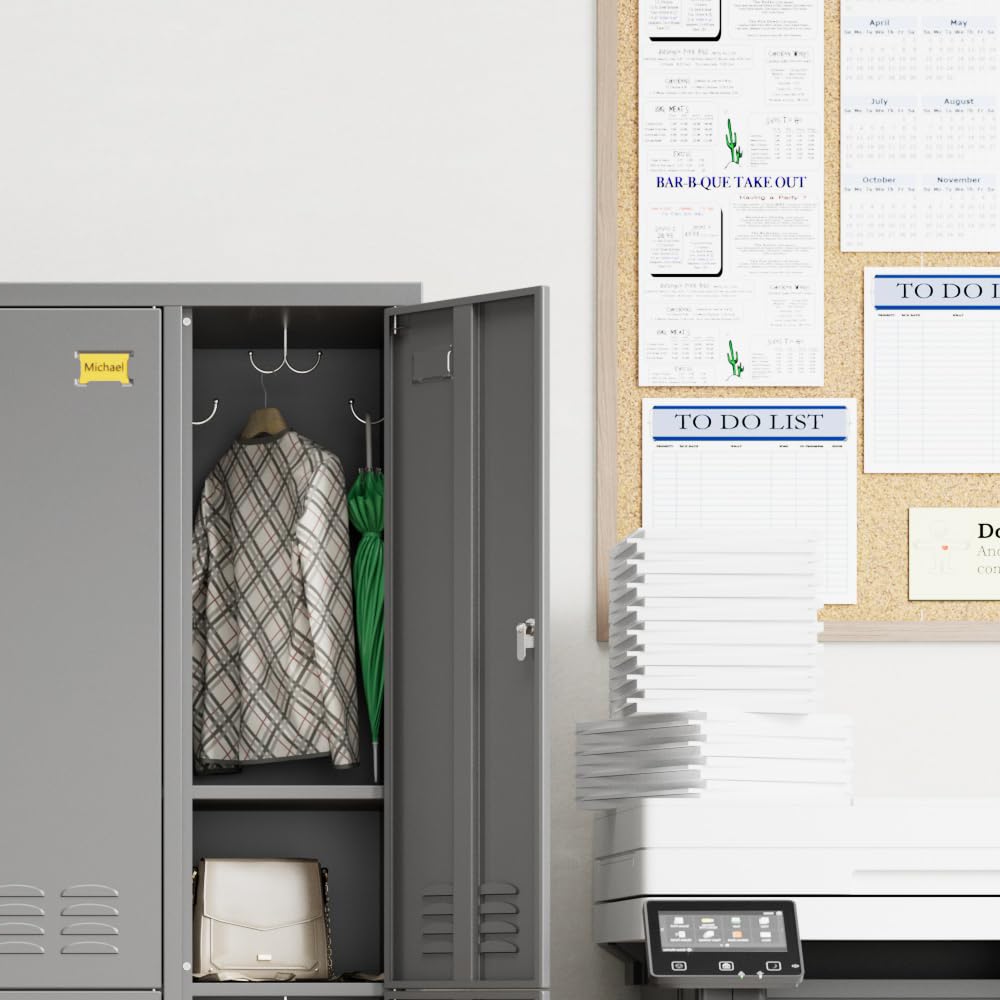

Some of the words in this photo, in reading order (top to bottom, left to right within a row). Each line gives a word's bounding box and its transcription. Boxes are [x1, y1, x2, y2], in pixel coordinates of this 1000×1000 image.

[869, 19, 890, 28] April
[950, 19, 968, 28] May
[871, 98, 888, 107] July
[944, 98, 975, 107] August
[656, 176, 732, 191] BAR-B-QUE
[733, 176, 772, 189] TAKE
[774, 176, 807, 189] OUT
[862, 176, 896, 184] October
[937, 176, 981, 184] November
[895, 283, 934, 299] TO
[941, 283, 983, 299] DO
[84, 362, 124, 373] Michael
[675, 413, 712, 430] TO
[720, 413, 762, 430] DO
[769, 413, 824, 430] LIST
